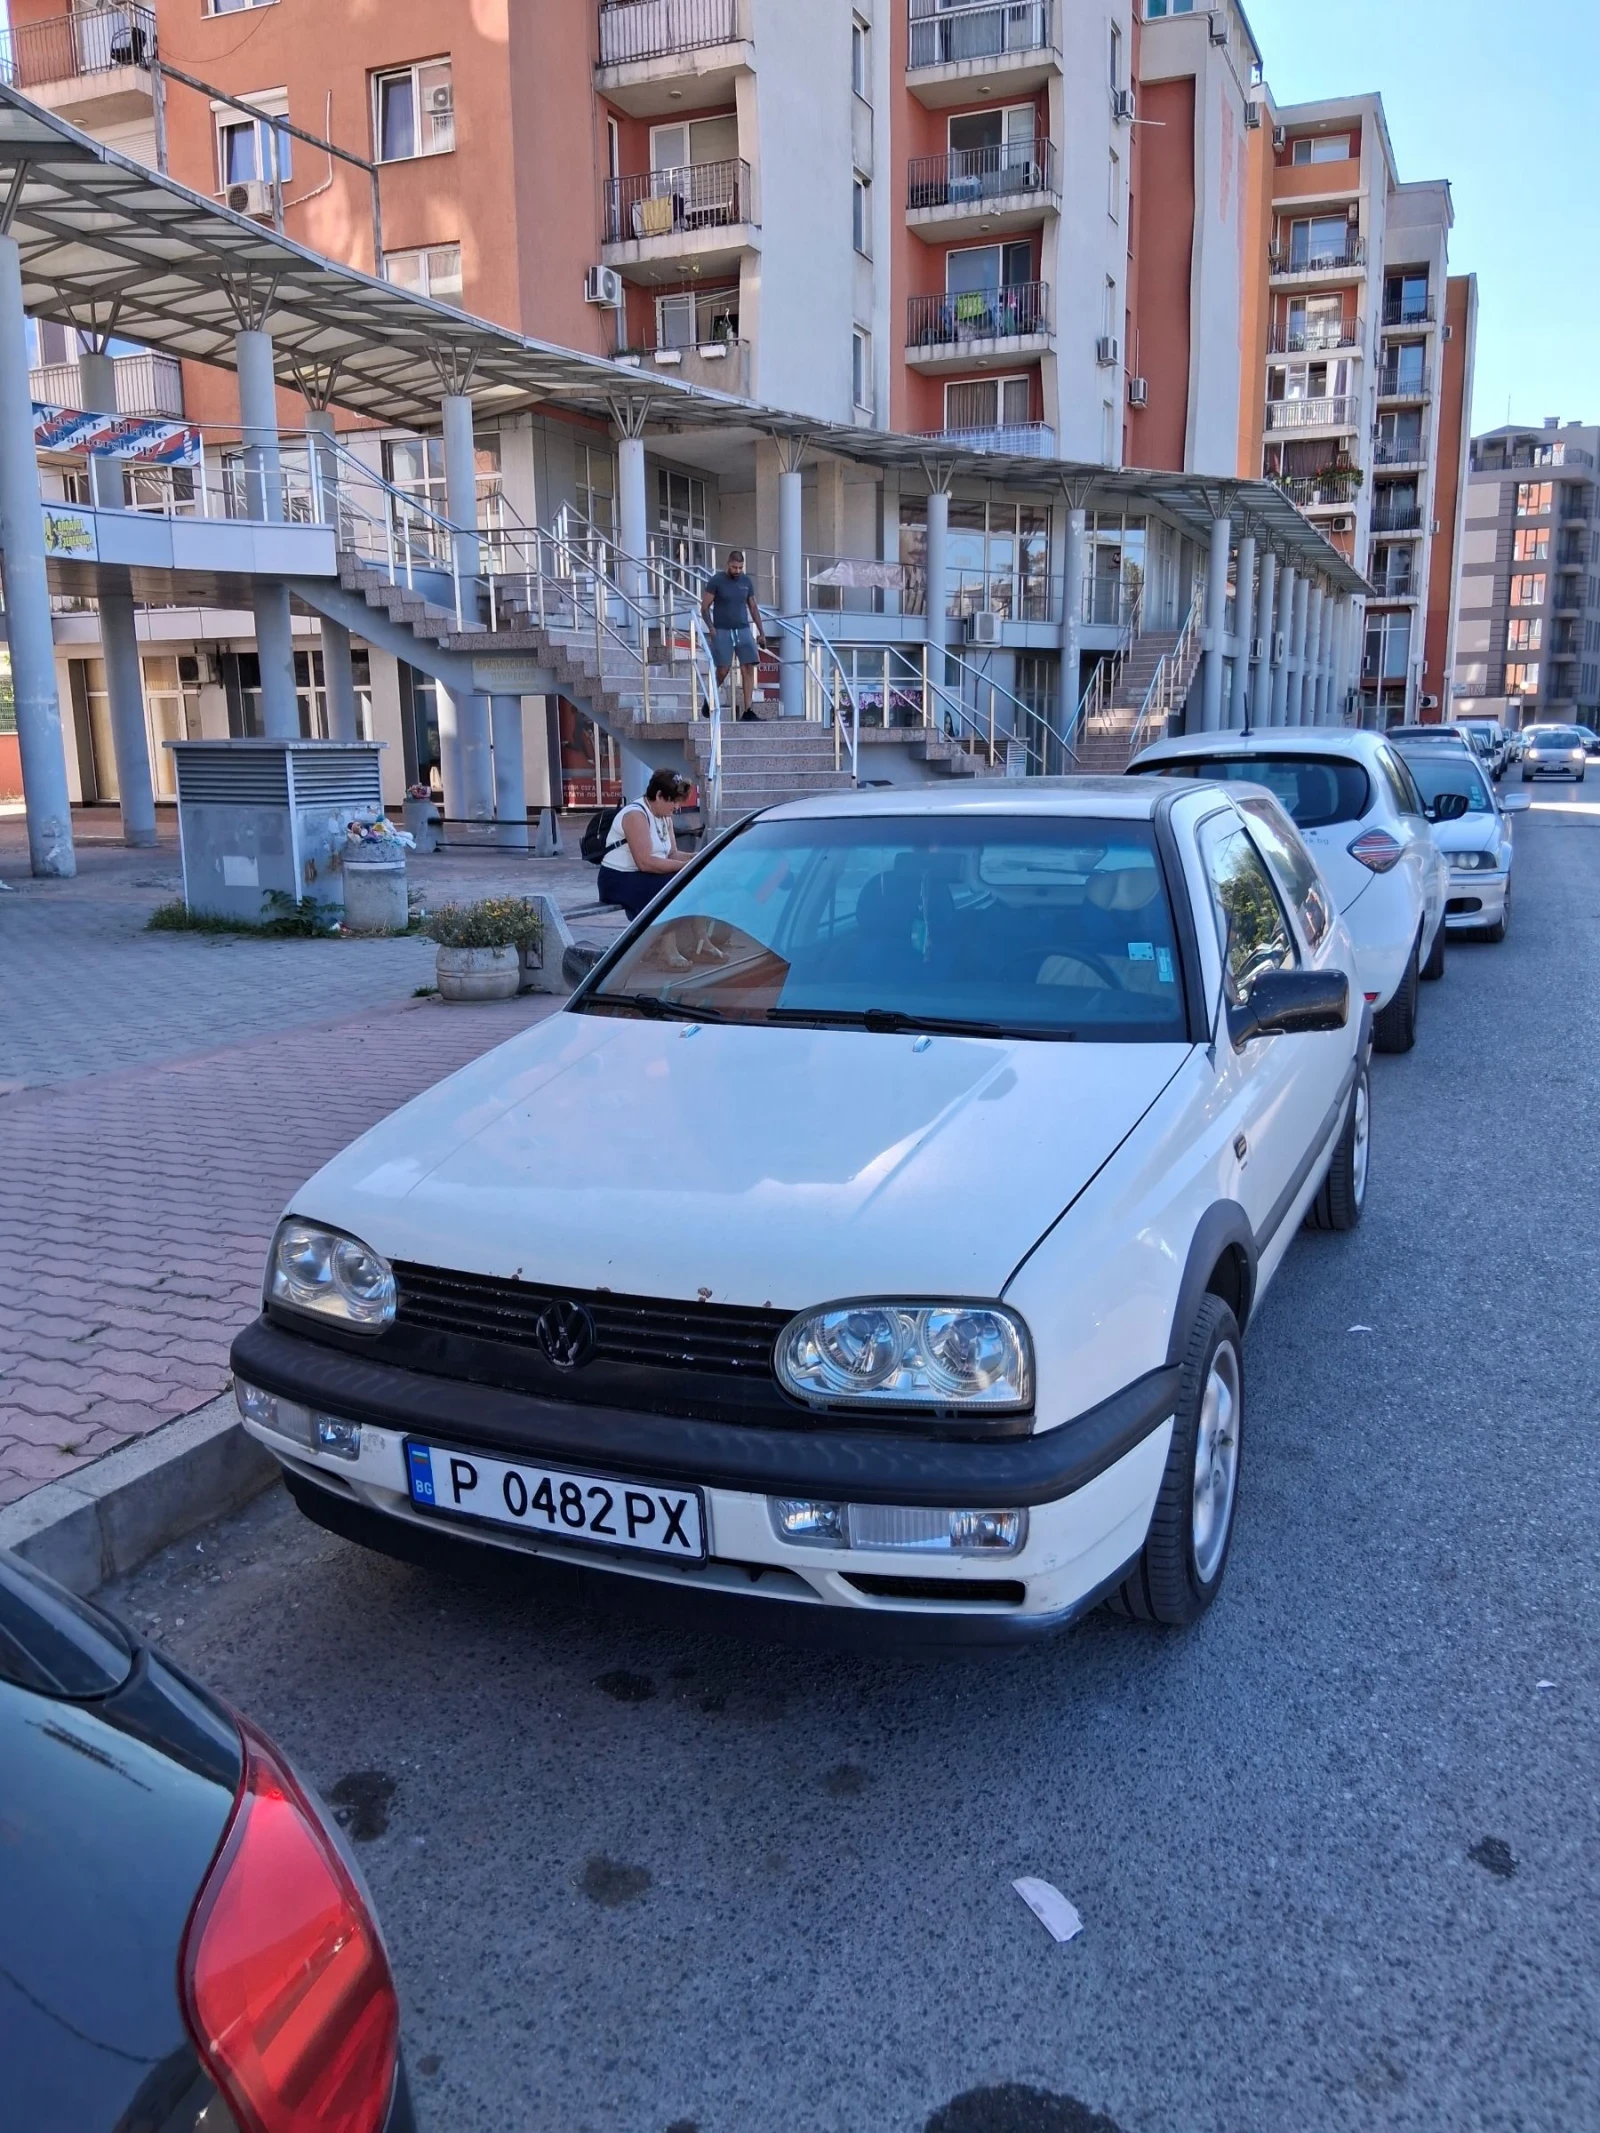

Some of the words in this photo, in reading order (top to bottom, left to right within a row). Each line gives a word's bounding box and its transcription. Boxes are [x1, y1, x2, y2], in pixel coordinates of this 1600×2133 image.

[39, 410, 101, 431] Master
[110, 420, 168, 440] Blade
[53, 429, 153, 456] Barbershop
[415, 1479, 433, 1496] BG
[450, 1458, 478, 1504] P
